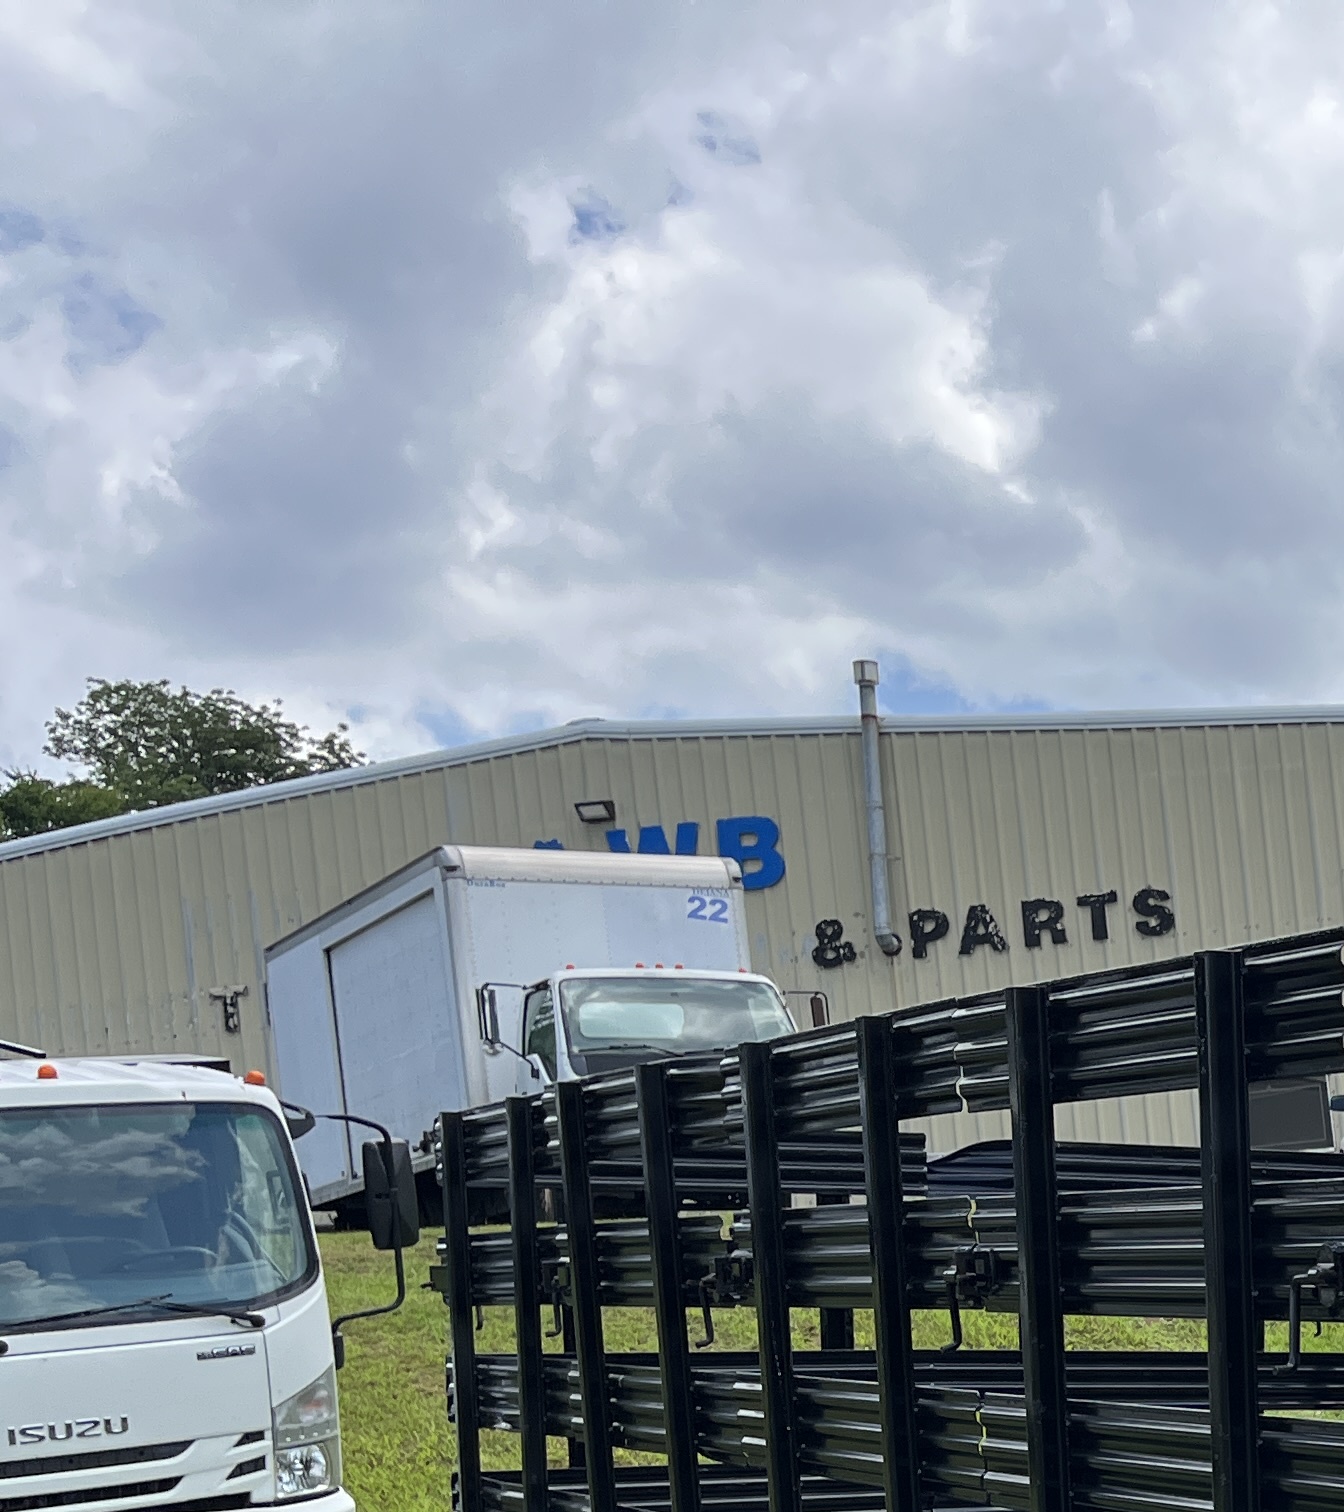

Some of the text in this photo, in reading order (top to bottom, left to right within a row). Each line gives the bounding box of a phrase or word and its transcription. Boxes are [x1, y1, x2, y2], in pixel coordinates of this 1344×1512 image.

[687, 895, 729, 924] 22
[812, 885, 1176, 969] & PARTS
[7, 1413, 129, 1447] ISUZU
